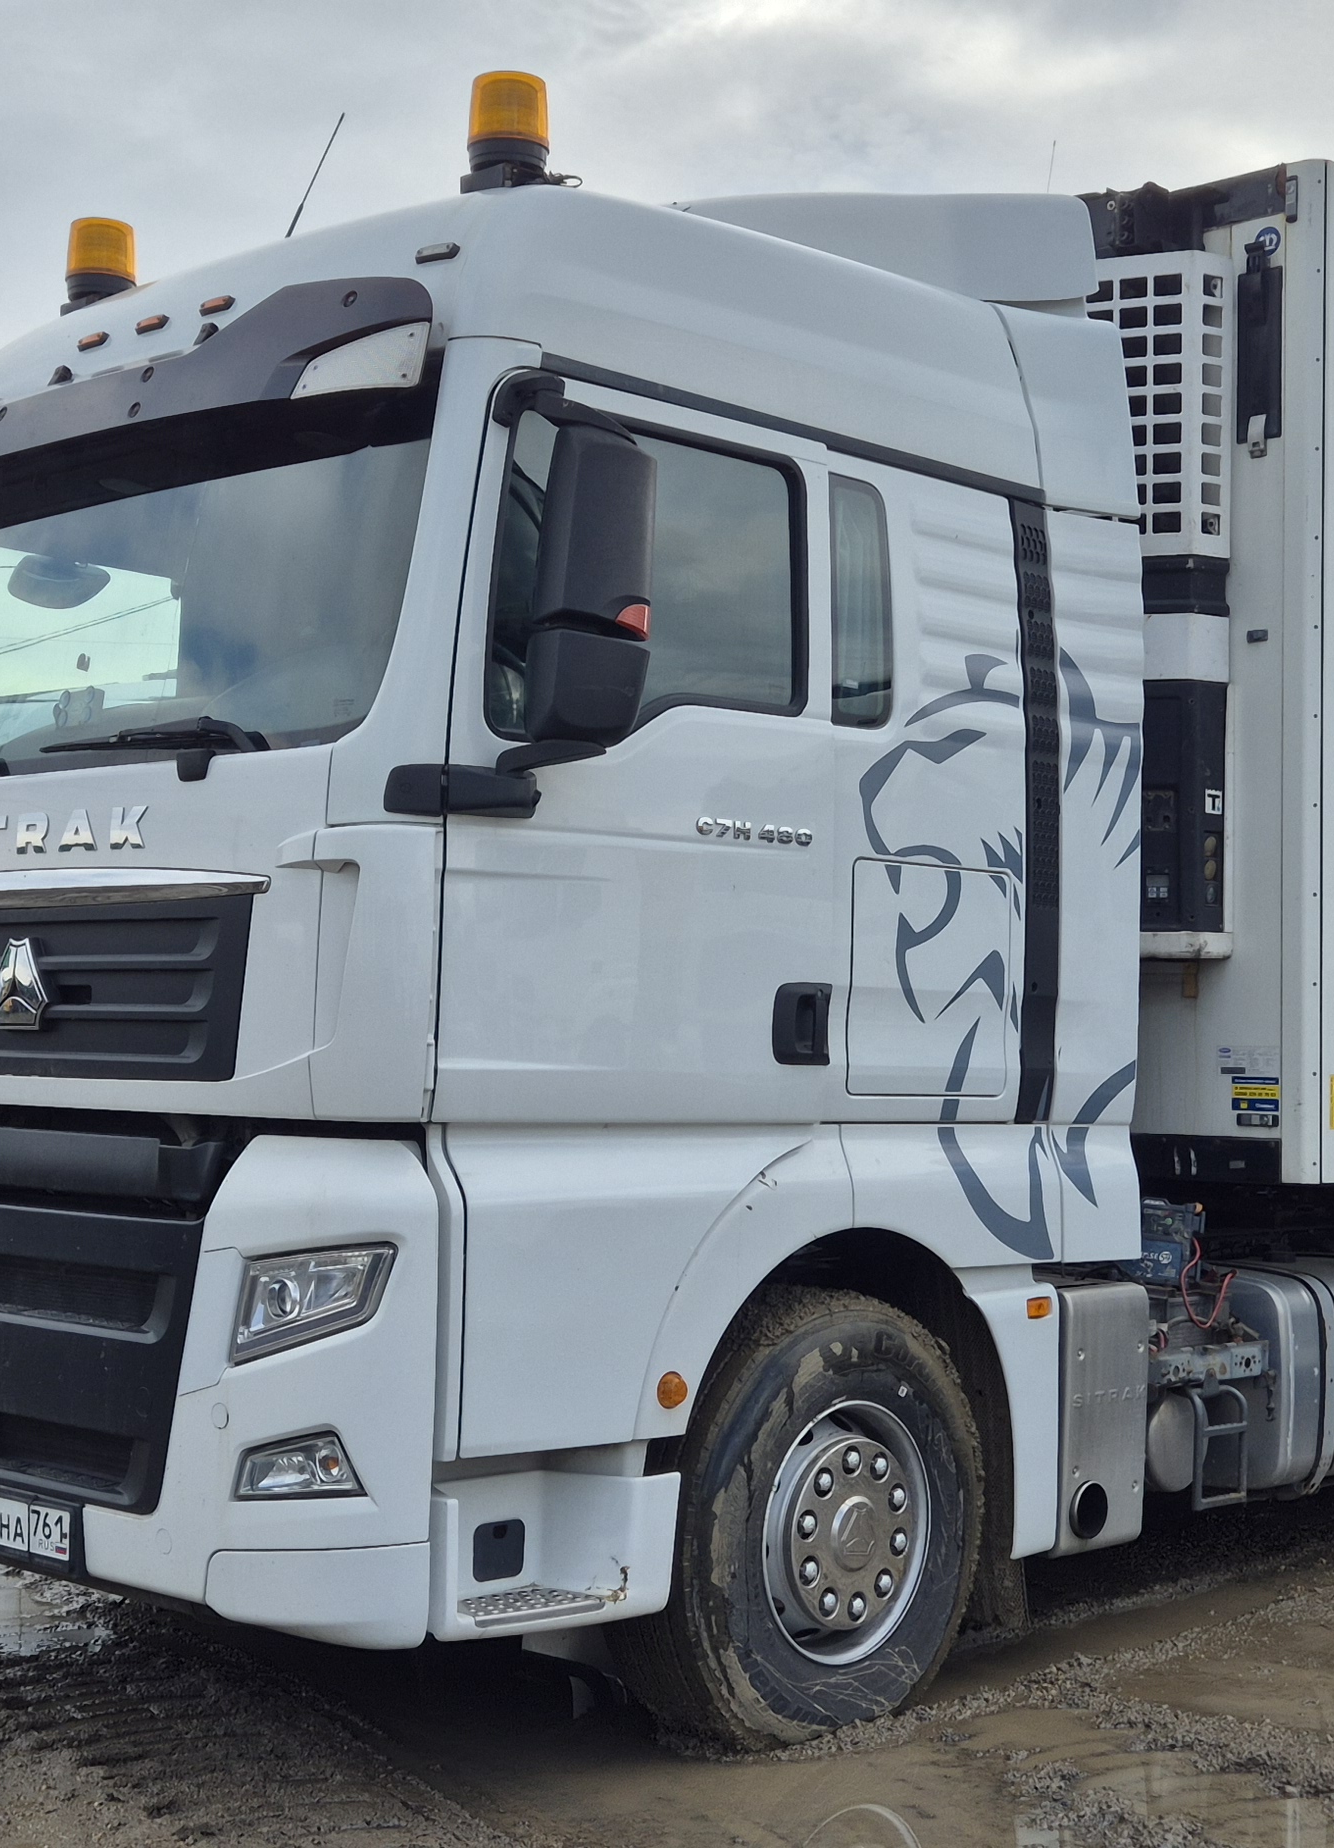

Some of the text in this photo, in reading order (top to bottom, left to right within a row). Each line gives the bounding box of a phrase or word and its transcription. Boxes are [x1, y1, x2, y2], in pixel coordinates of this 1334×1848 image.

[696, 816, 813, 847] C7H 480
[38, 1538, 55, 1552] RUS
